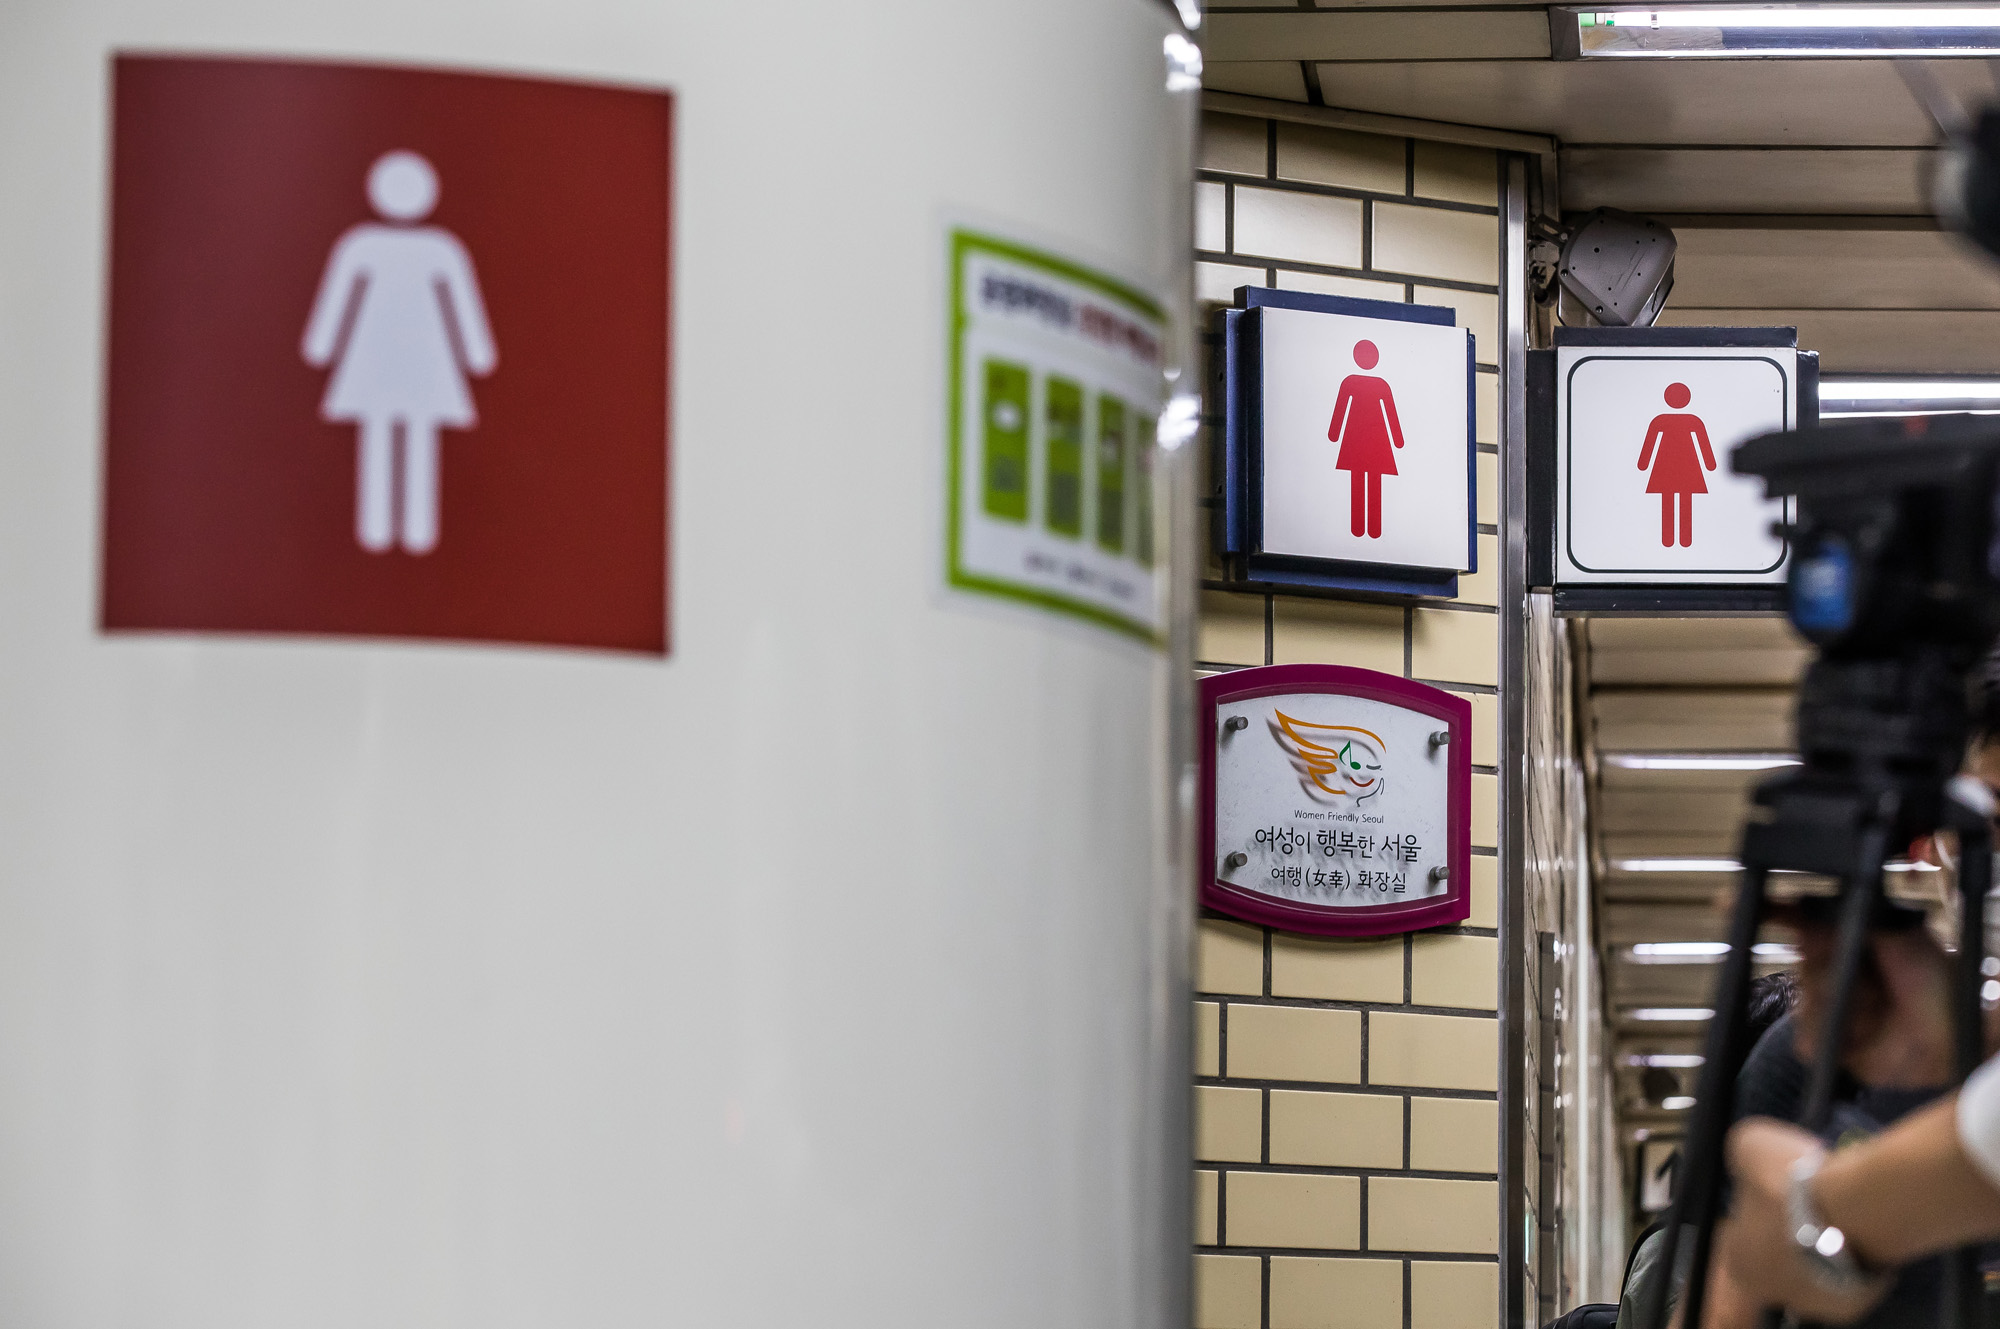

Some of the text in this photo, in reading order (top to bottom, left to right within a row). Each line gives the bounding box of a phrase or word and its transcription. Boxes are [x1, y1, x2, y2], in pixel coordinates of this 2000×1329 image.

[1294, 809, 1384, 824] Women Friendly Seoul
[1255, 825, 1422, 862] 여성이 행복한 서울
[1357, 869, 1406, 893] 화장실
